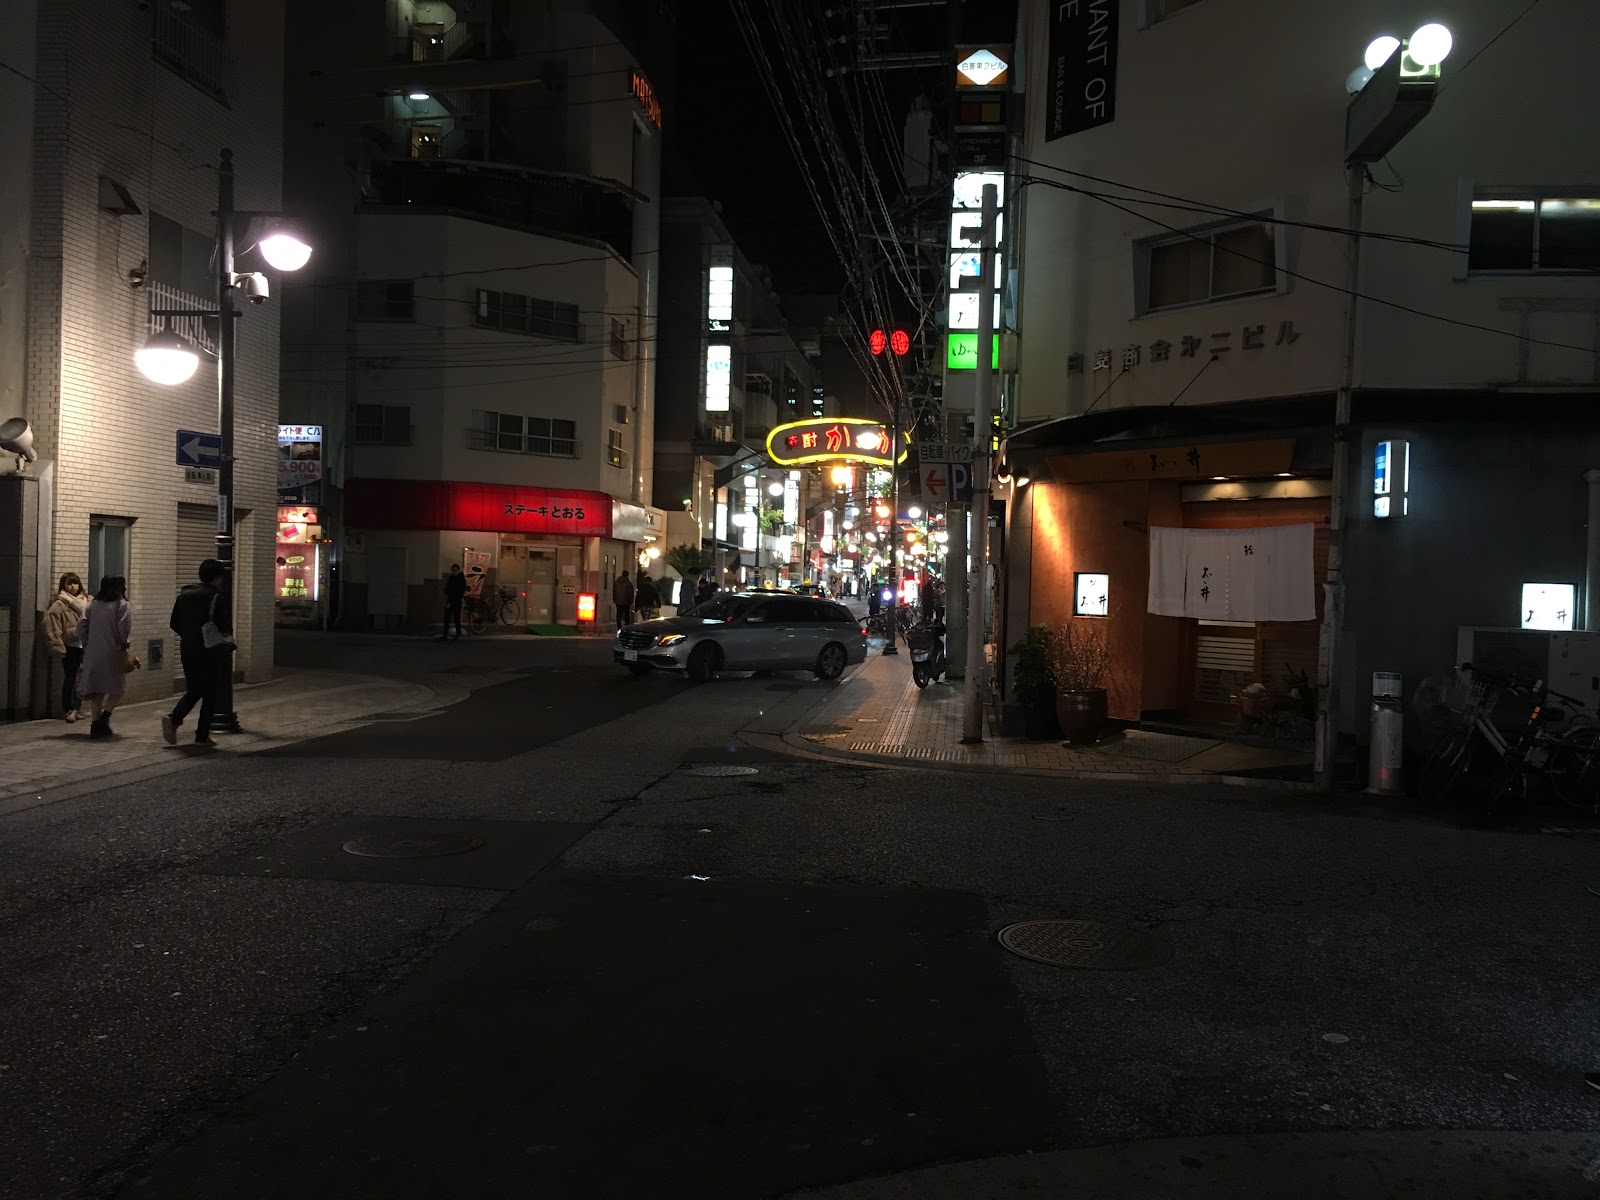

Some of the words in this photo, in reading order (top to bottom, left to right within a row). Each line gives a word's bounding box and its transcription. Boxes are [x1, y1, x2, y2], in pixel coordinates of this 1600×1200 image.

[1056, 56, 1065, 79] BAR
[1054, 90, 1065, 134] LOUNGE
[1084, 77, 1106, 119] OF
[973, 154, 987, 163] 3F
[951, 464, 968, 501] P
